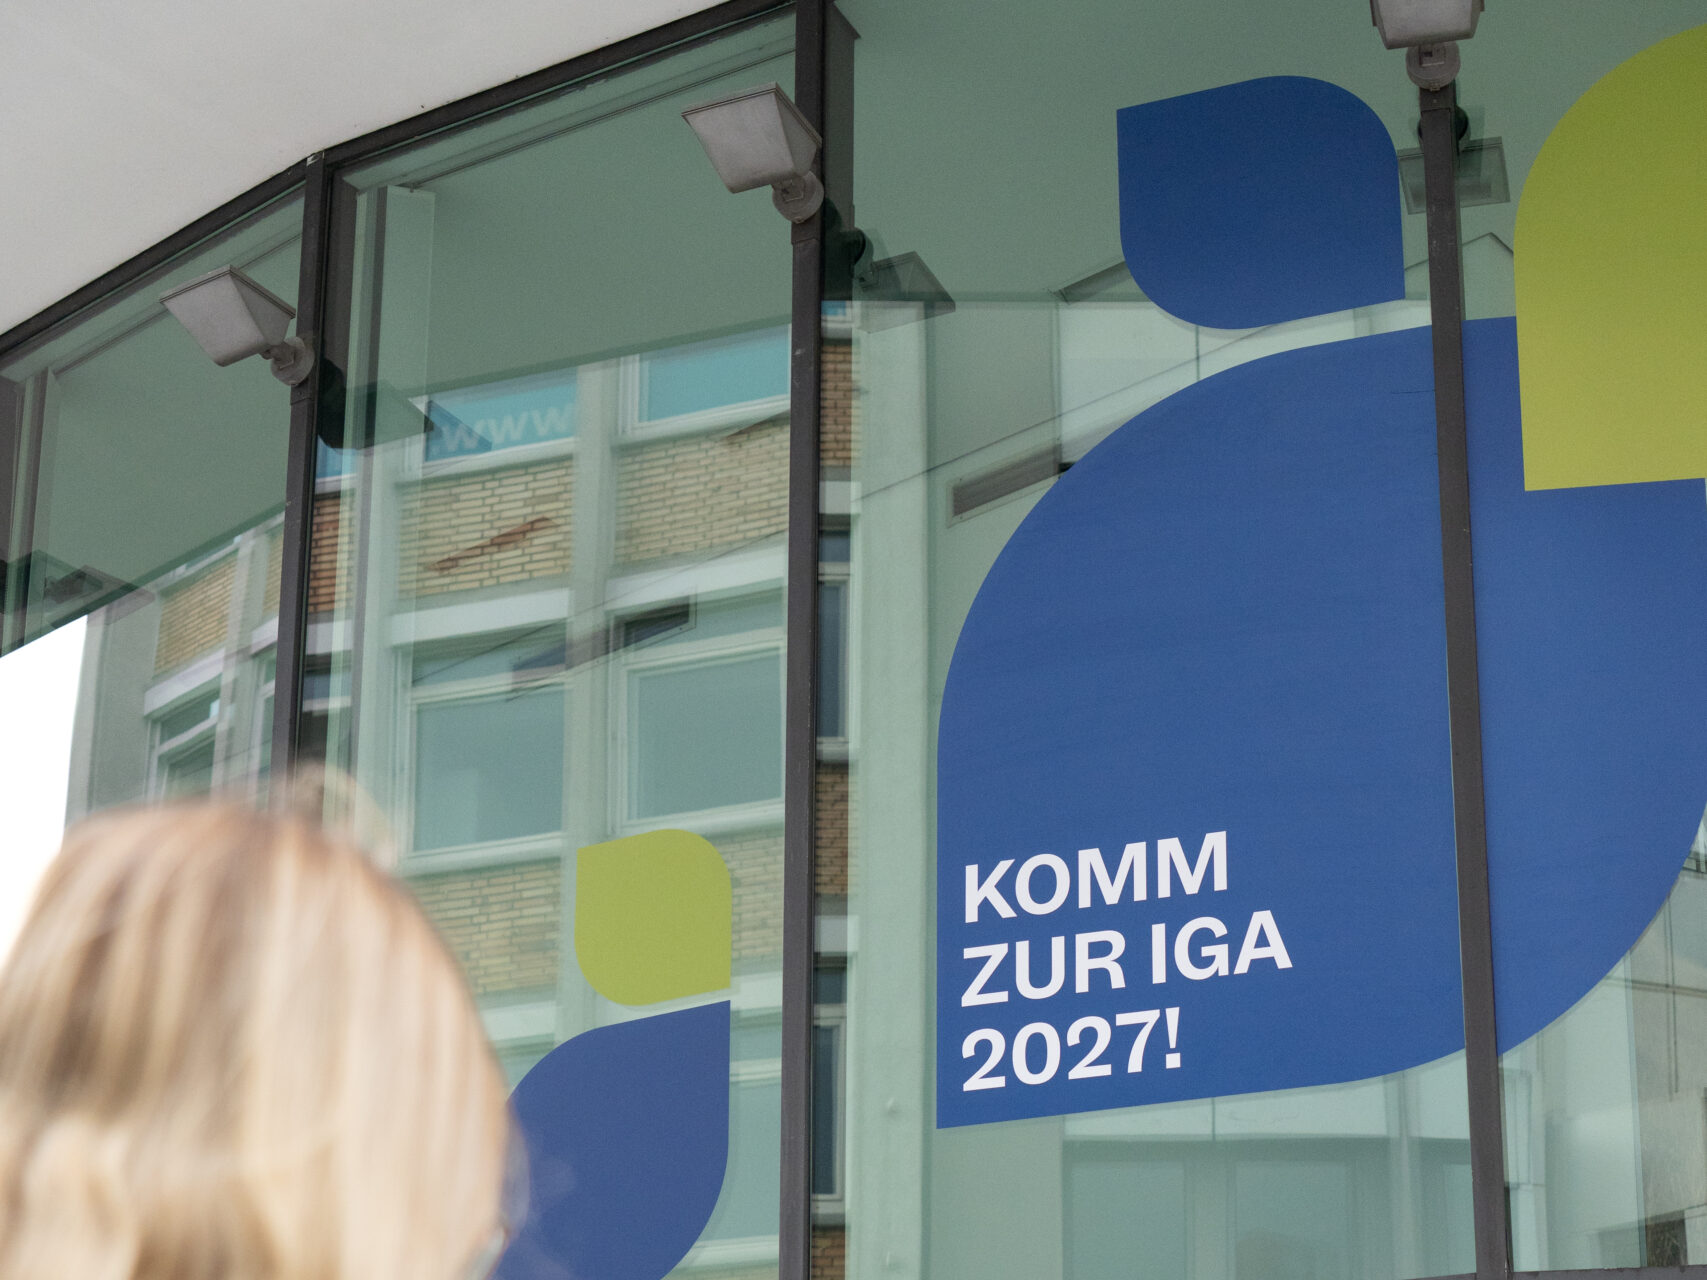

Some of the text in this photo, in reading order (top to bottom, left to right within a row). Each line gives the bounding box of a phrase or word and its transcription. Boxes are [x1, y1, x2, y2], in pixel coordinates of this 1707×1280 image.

[965, 831, 1227, 923] KOMM
[961, 910, 1293, 1007] ZUR IGA
[961, 1006, 1181, 1092] 2027!
